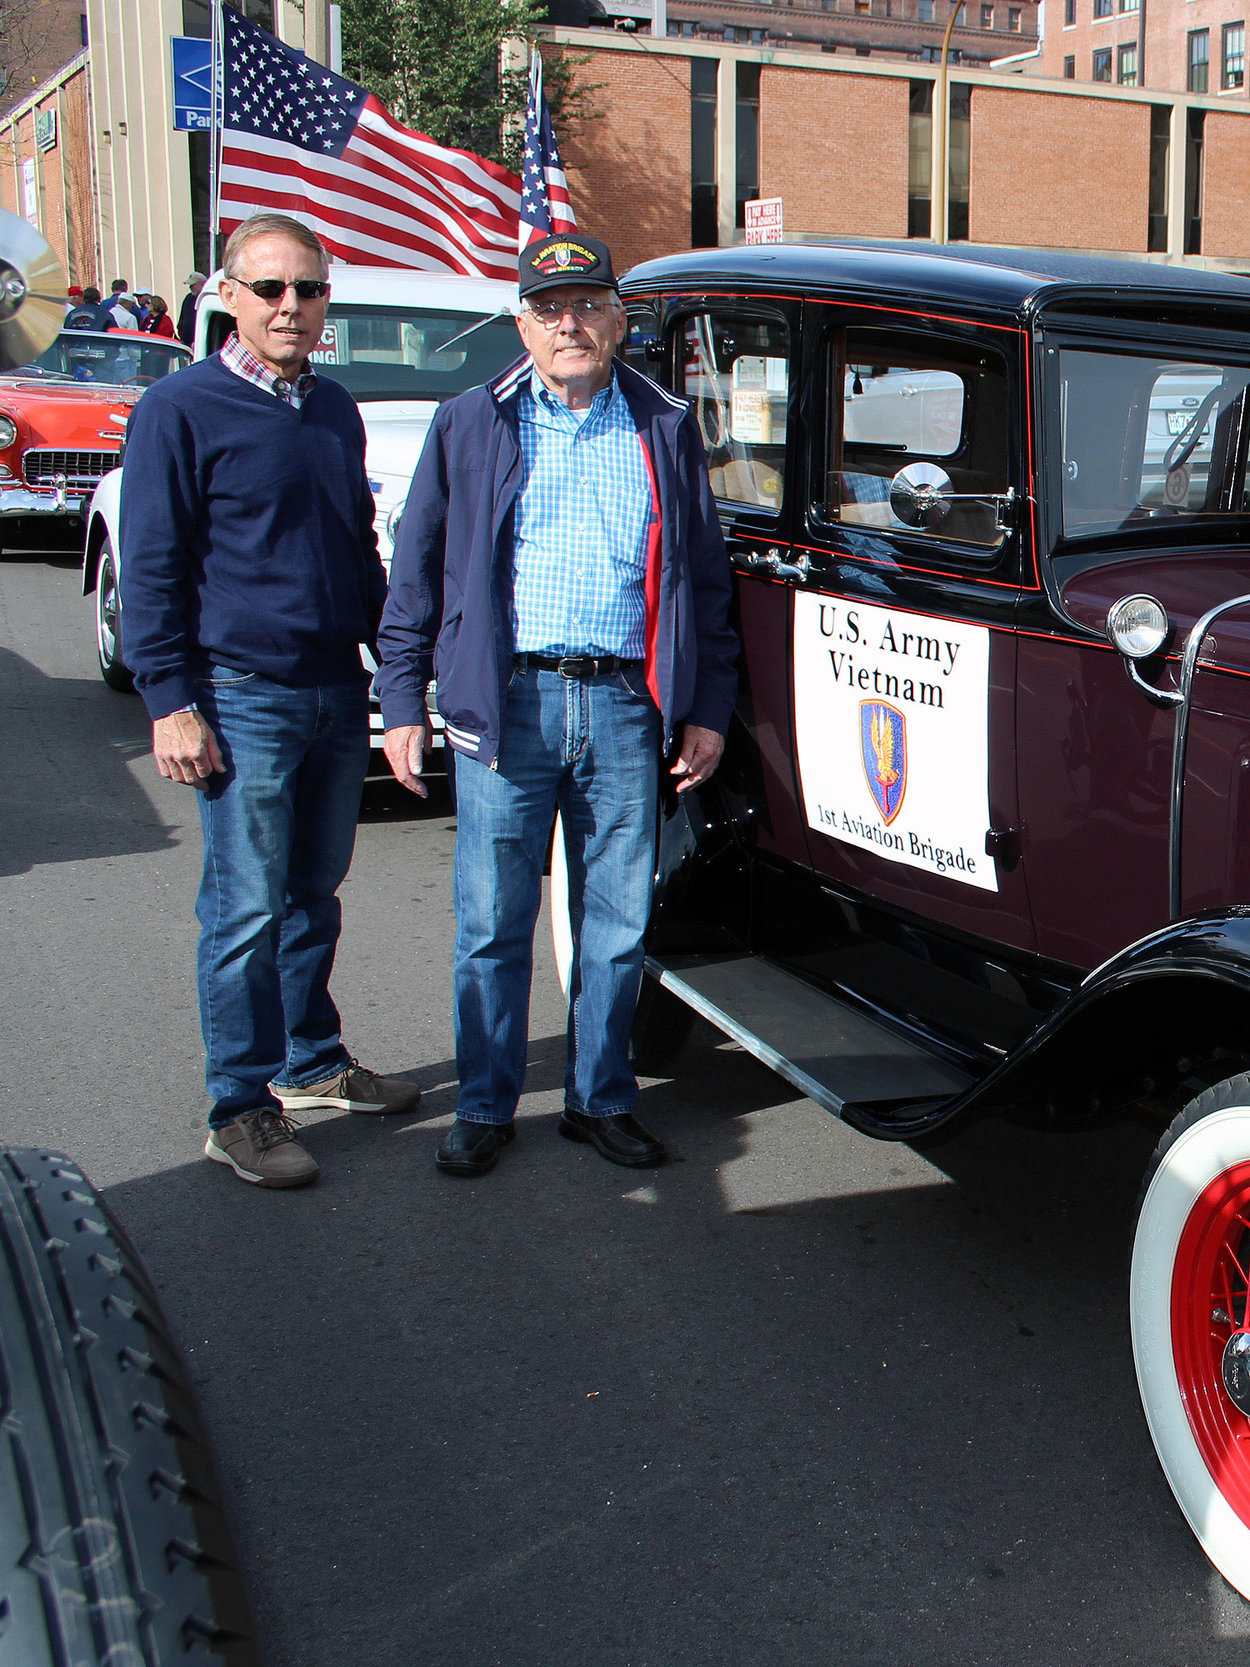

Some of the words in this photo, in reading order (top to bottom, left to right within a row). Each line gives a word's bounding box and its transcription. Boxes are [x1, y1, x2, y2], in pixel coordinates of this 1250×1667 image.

[752, 206, 762, 217] PAY
[763, 204, 776, 216] HERE
[538, 242, 568, 259] AVIATION
[568, 242, 598, 263] BRIGADE
[747, 230, 763, 245] PARK
[766, 229, 781, 243] HERE
[818, 603, 868, 646] U.S.
[879, 618, 961, 676] Army
[828, 649, 945, 709] Vietnam
[817, 804, 838, 828] 1st
[841, 810, 905, 852] Aviation
[908, 831, 977, 874] Brigade
